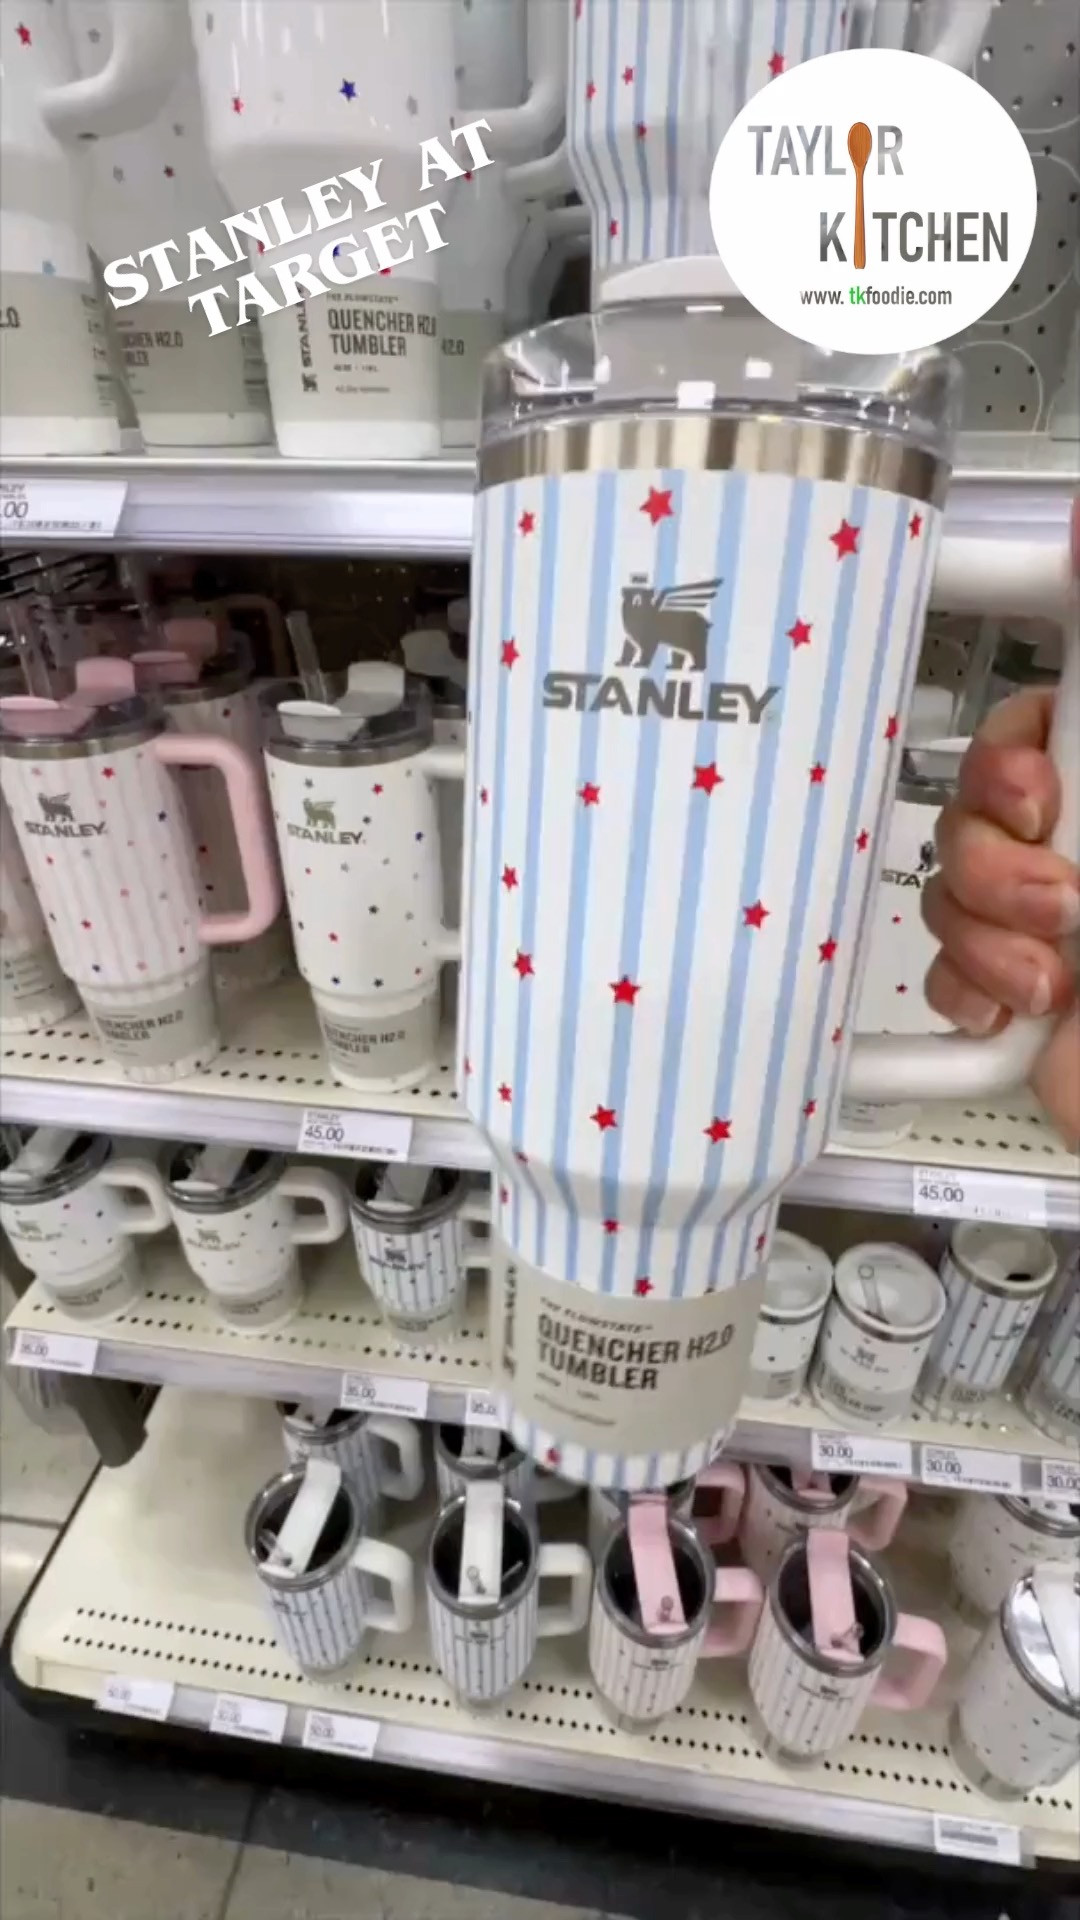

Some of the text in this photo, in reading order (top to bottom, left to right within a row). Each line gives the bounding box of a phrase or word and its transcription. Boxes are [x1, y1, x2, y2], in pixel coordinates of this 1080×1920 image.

[327, 308, 414, 334] QUENCHER
[330, 334, 407, 357] TUMBLER
[543, 671, 782, 724] STANLEY
[24, 820, 107, 838] STANLEY
[287, 823, 364, 845] STANLEY
[881, 869, 921, 888] STA
[305, 1125, 344, 1141] 45.00
[919, 1185, 964, 1202] 45.00
[538, 1313, 680, 1364] QUENCHER
[538, 1339, 659, 1390] TUMBLER
[819, 1445, 853, 1459] 30.00
[926, 1459, 962, 1475] 30.00
